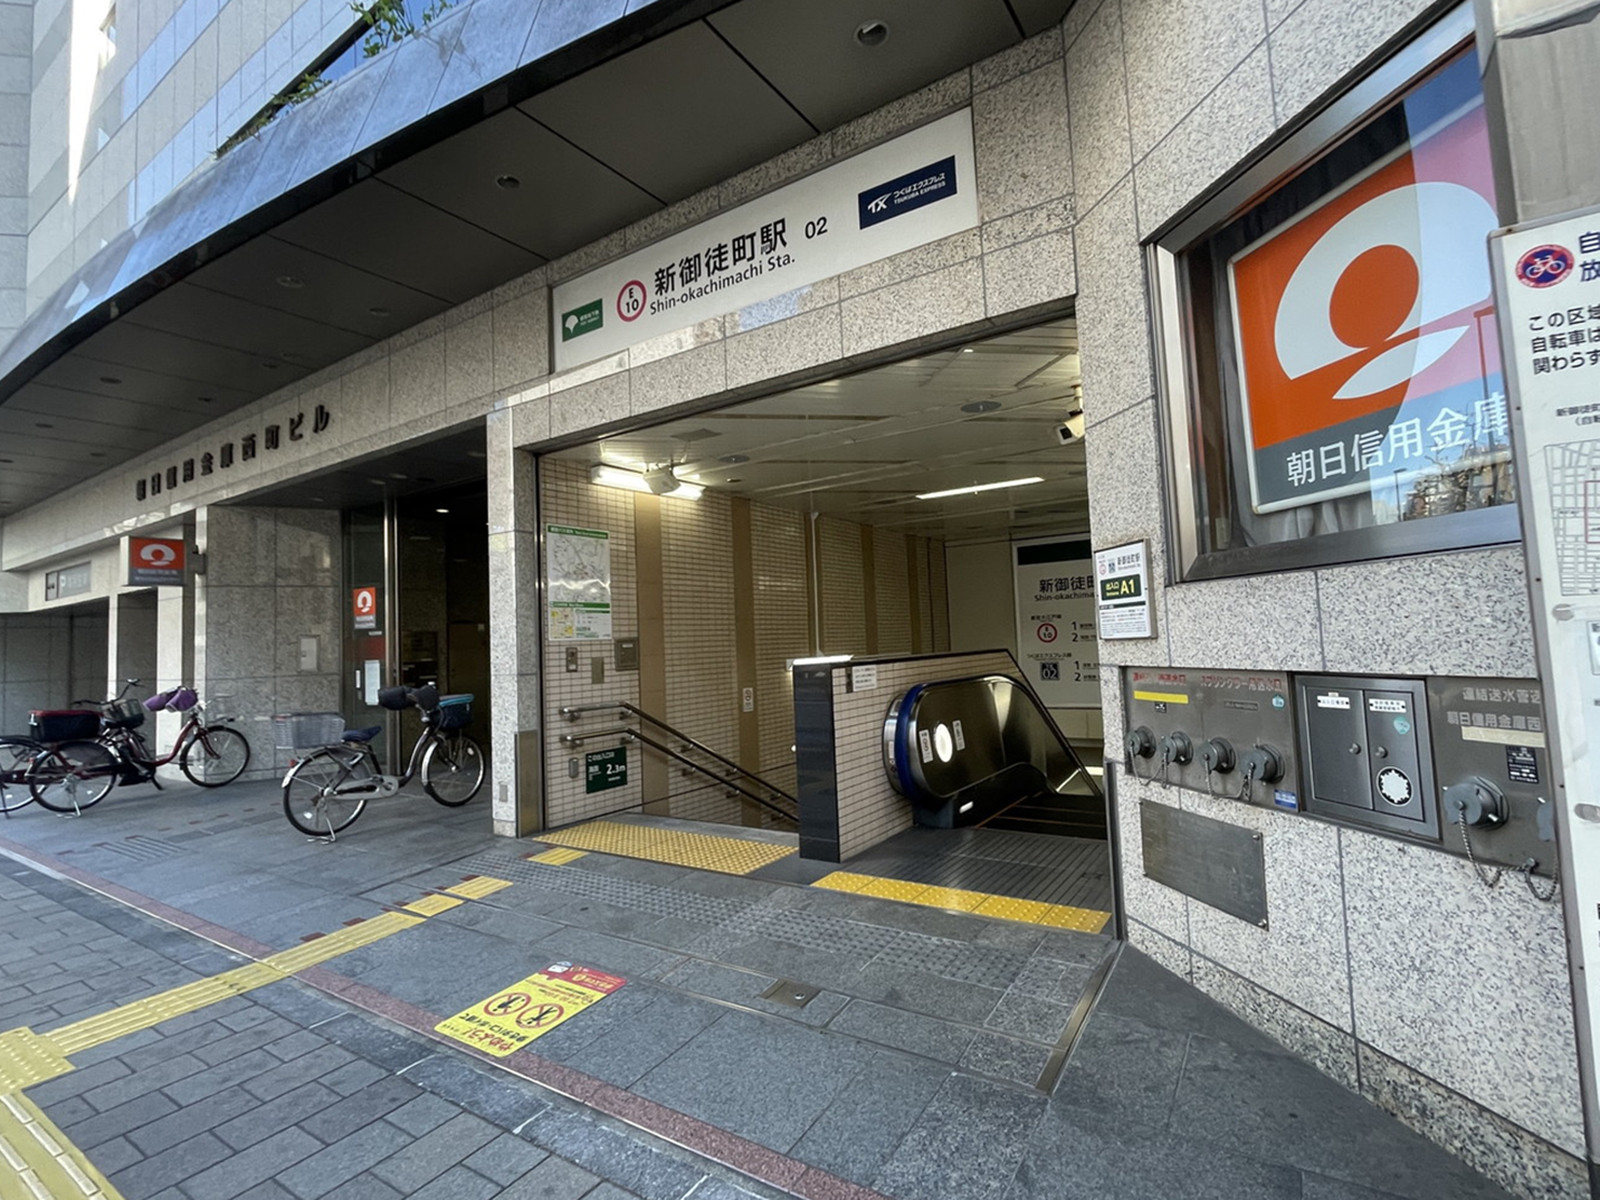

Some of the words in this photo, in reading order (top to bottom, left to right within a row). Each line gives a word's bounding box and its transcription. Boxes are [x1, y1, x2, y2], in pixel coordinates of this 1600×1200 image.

[893, 172, 946, 198] つくばエクスプレス
[893, 191, 919, 205] TSUKUBA
[919, 181, 946, 195] EXPRESS
[867, 192, 892, 214] TX
[654, 217, 787, 296] 新御徒町駅
[805, 216, 828, 239] 02
[650, 260, 763, 315] Shin-okachimachi
[767, 253, 796, 272] Sta.
[628, 287, 634, 299] E
[625, 298, 640, 314] 10
[1286, 391, 1508, 487] 朝日信用金庫
[1120, 578, 1136, 596] A1
[1071, 620, 1078, 631] 1
[1071, 632, 1079, 642] 2
[1042, 667, 1058, 679] 02
[1074, 660, 1080, 670] 1
[1074, 671, 1081, 682] 2
